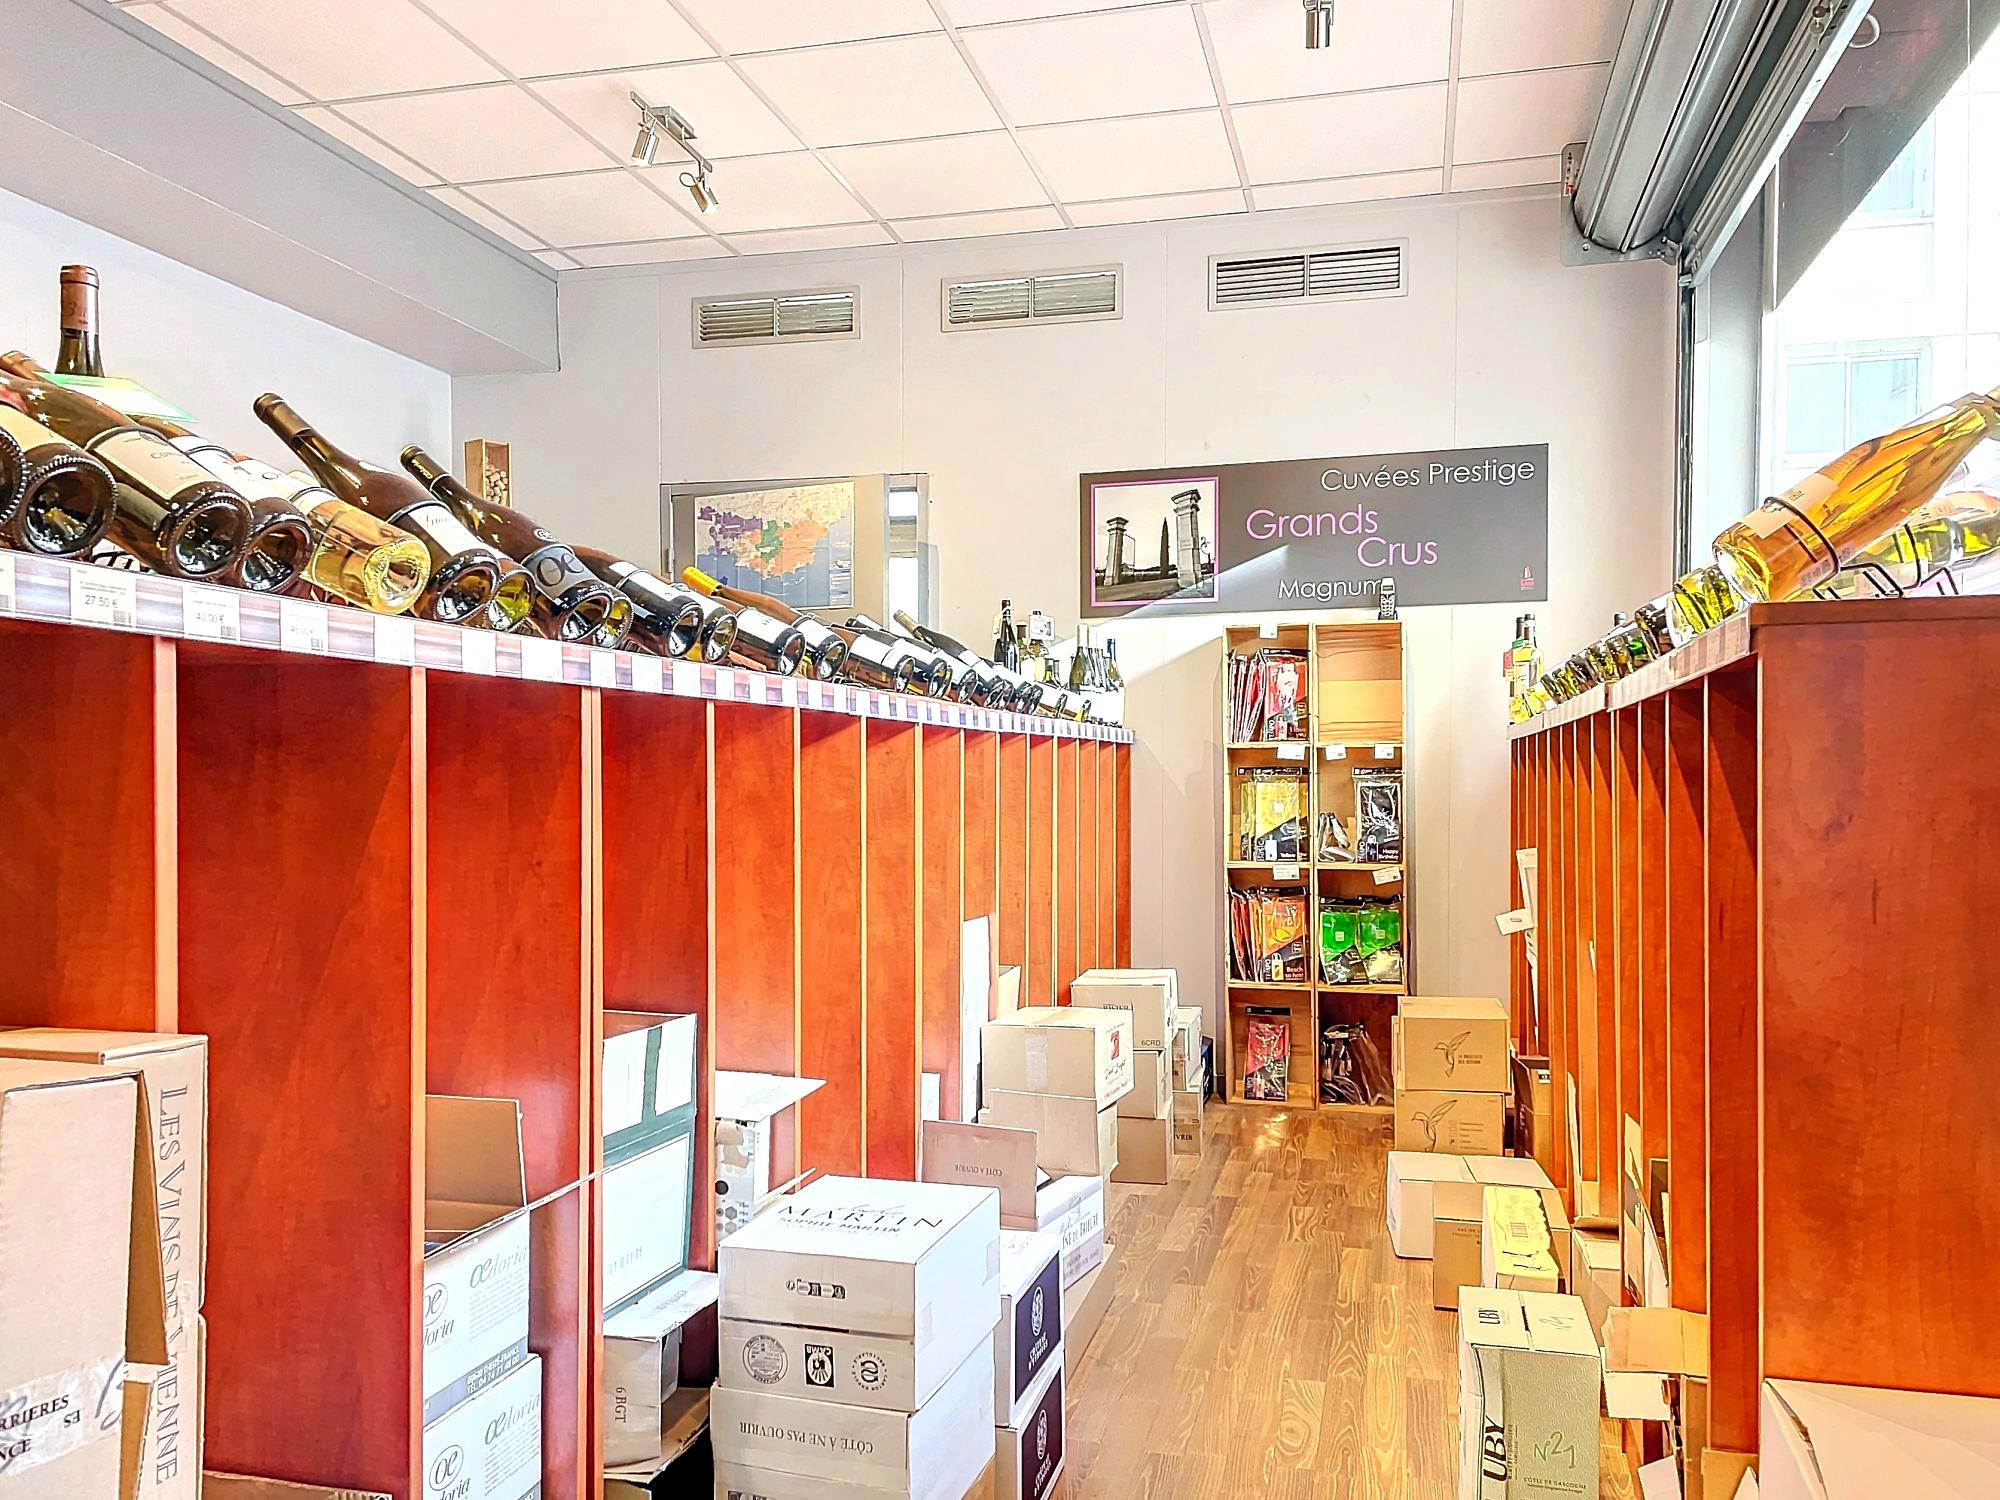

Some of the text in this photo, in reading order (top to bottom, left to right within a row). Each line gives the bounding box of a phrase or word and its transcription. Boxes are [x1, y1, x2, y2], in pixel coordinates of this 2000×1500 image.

[1321, 458, 1535, 491] Cuvées Prestige
[1246, 503, 1379, 540] Grands
[1357, 536, 1438, 568] Crus
[159, 1085, 188, 1160] LES
[158, 1159, 187, 1268] VINS
[778, 1205, 943, 1228] MARTIN
[838, 1223, 901, 1233] MARTIN
[615, 1396, 627, 1423] BGT
[740, 1422, 784, 1439] OUVRIR
[787, 1429, 806, 1443] PAS
[809, 1433, 826, 1447] NE
[841, 1437, 874, 1455] CÔTÉ
[1483, 1415, 1508, 1482] UBY
[1553, 1480, 1587, 1490] GASCOGNE
